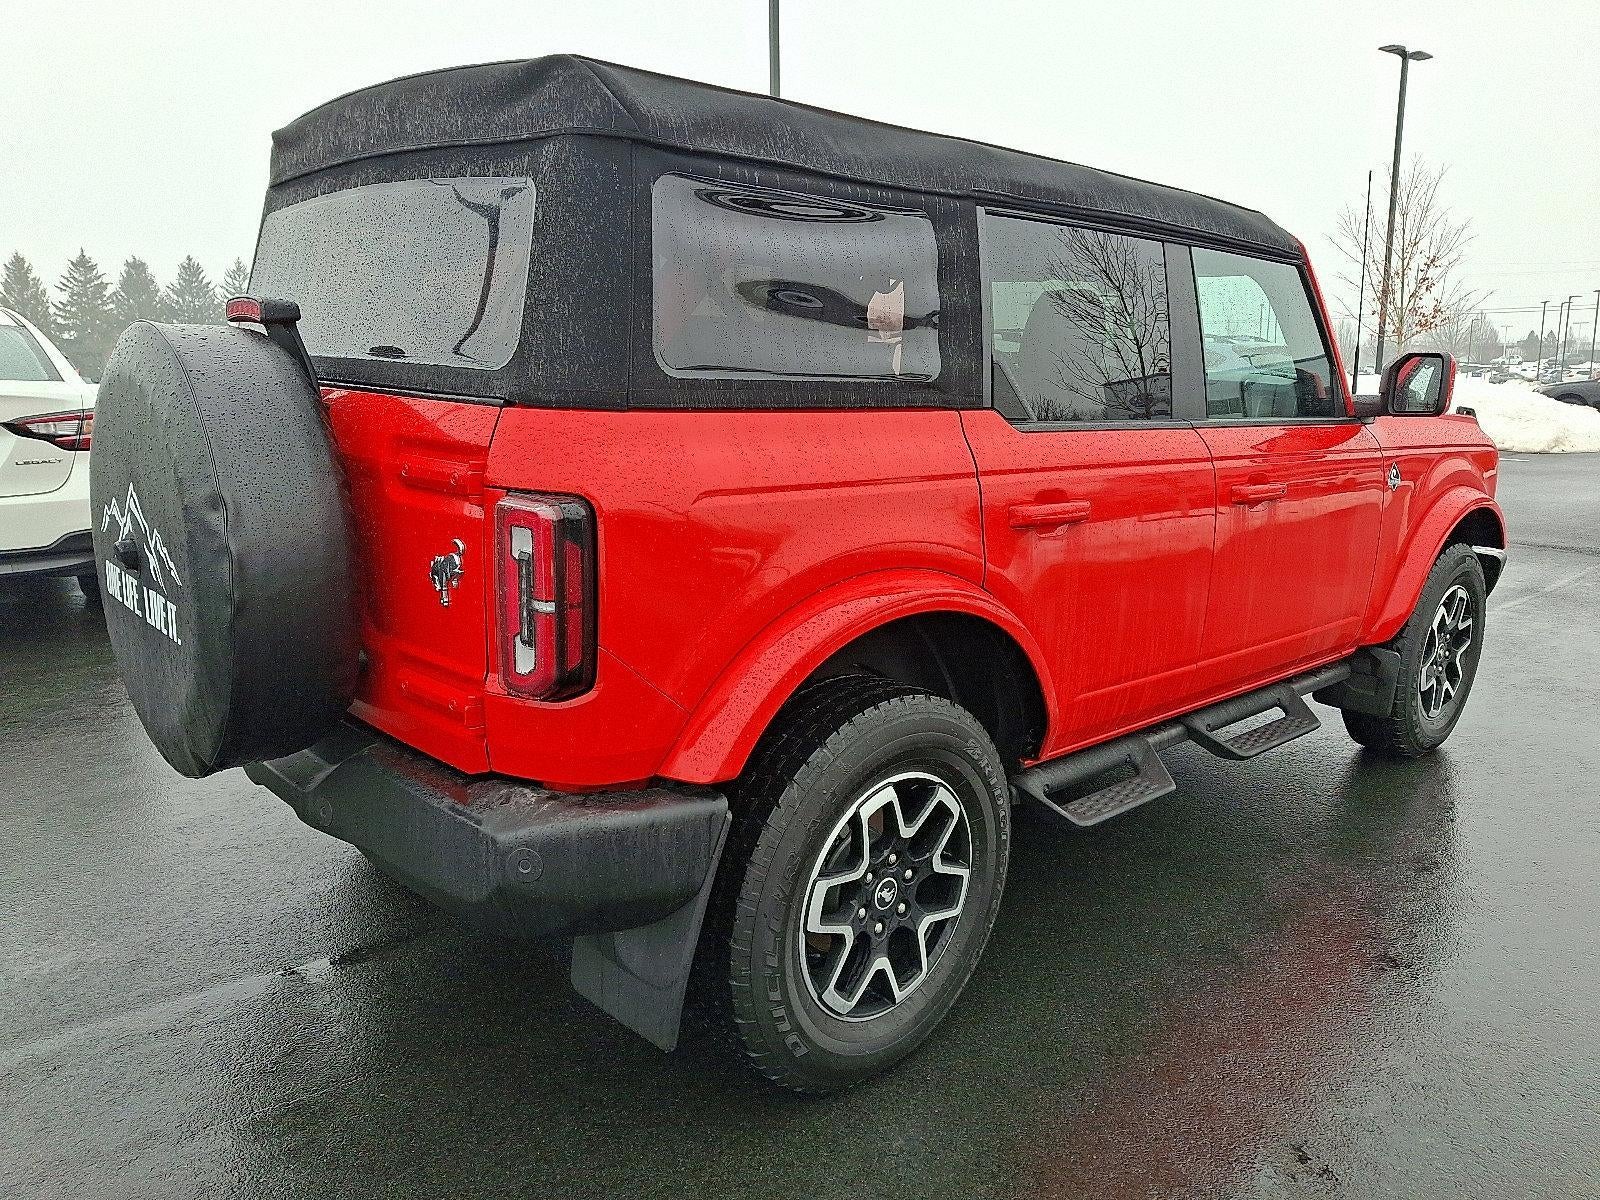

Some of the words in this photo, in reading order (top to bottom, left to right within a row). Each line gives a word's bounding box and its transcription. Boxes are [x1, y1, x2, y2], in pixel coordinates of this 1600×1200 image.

[14, 458, 63, 466] LEGACY
[105, 560, 122, 602] ONE
[143, 586, 168, 635] LIVE
[167, 600, 182, 645] IT.
